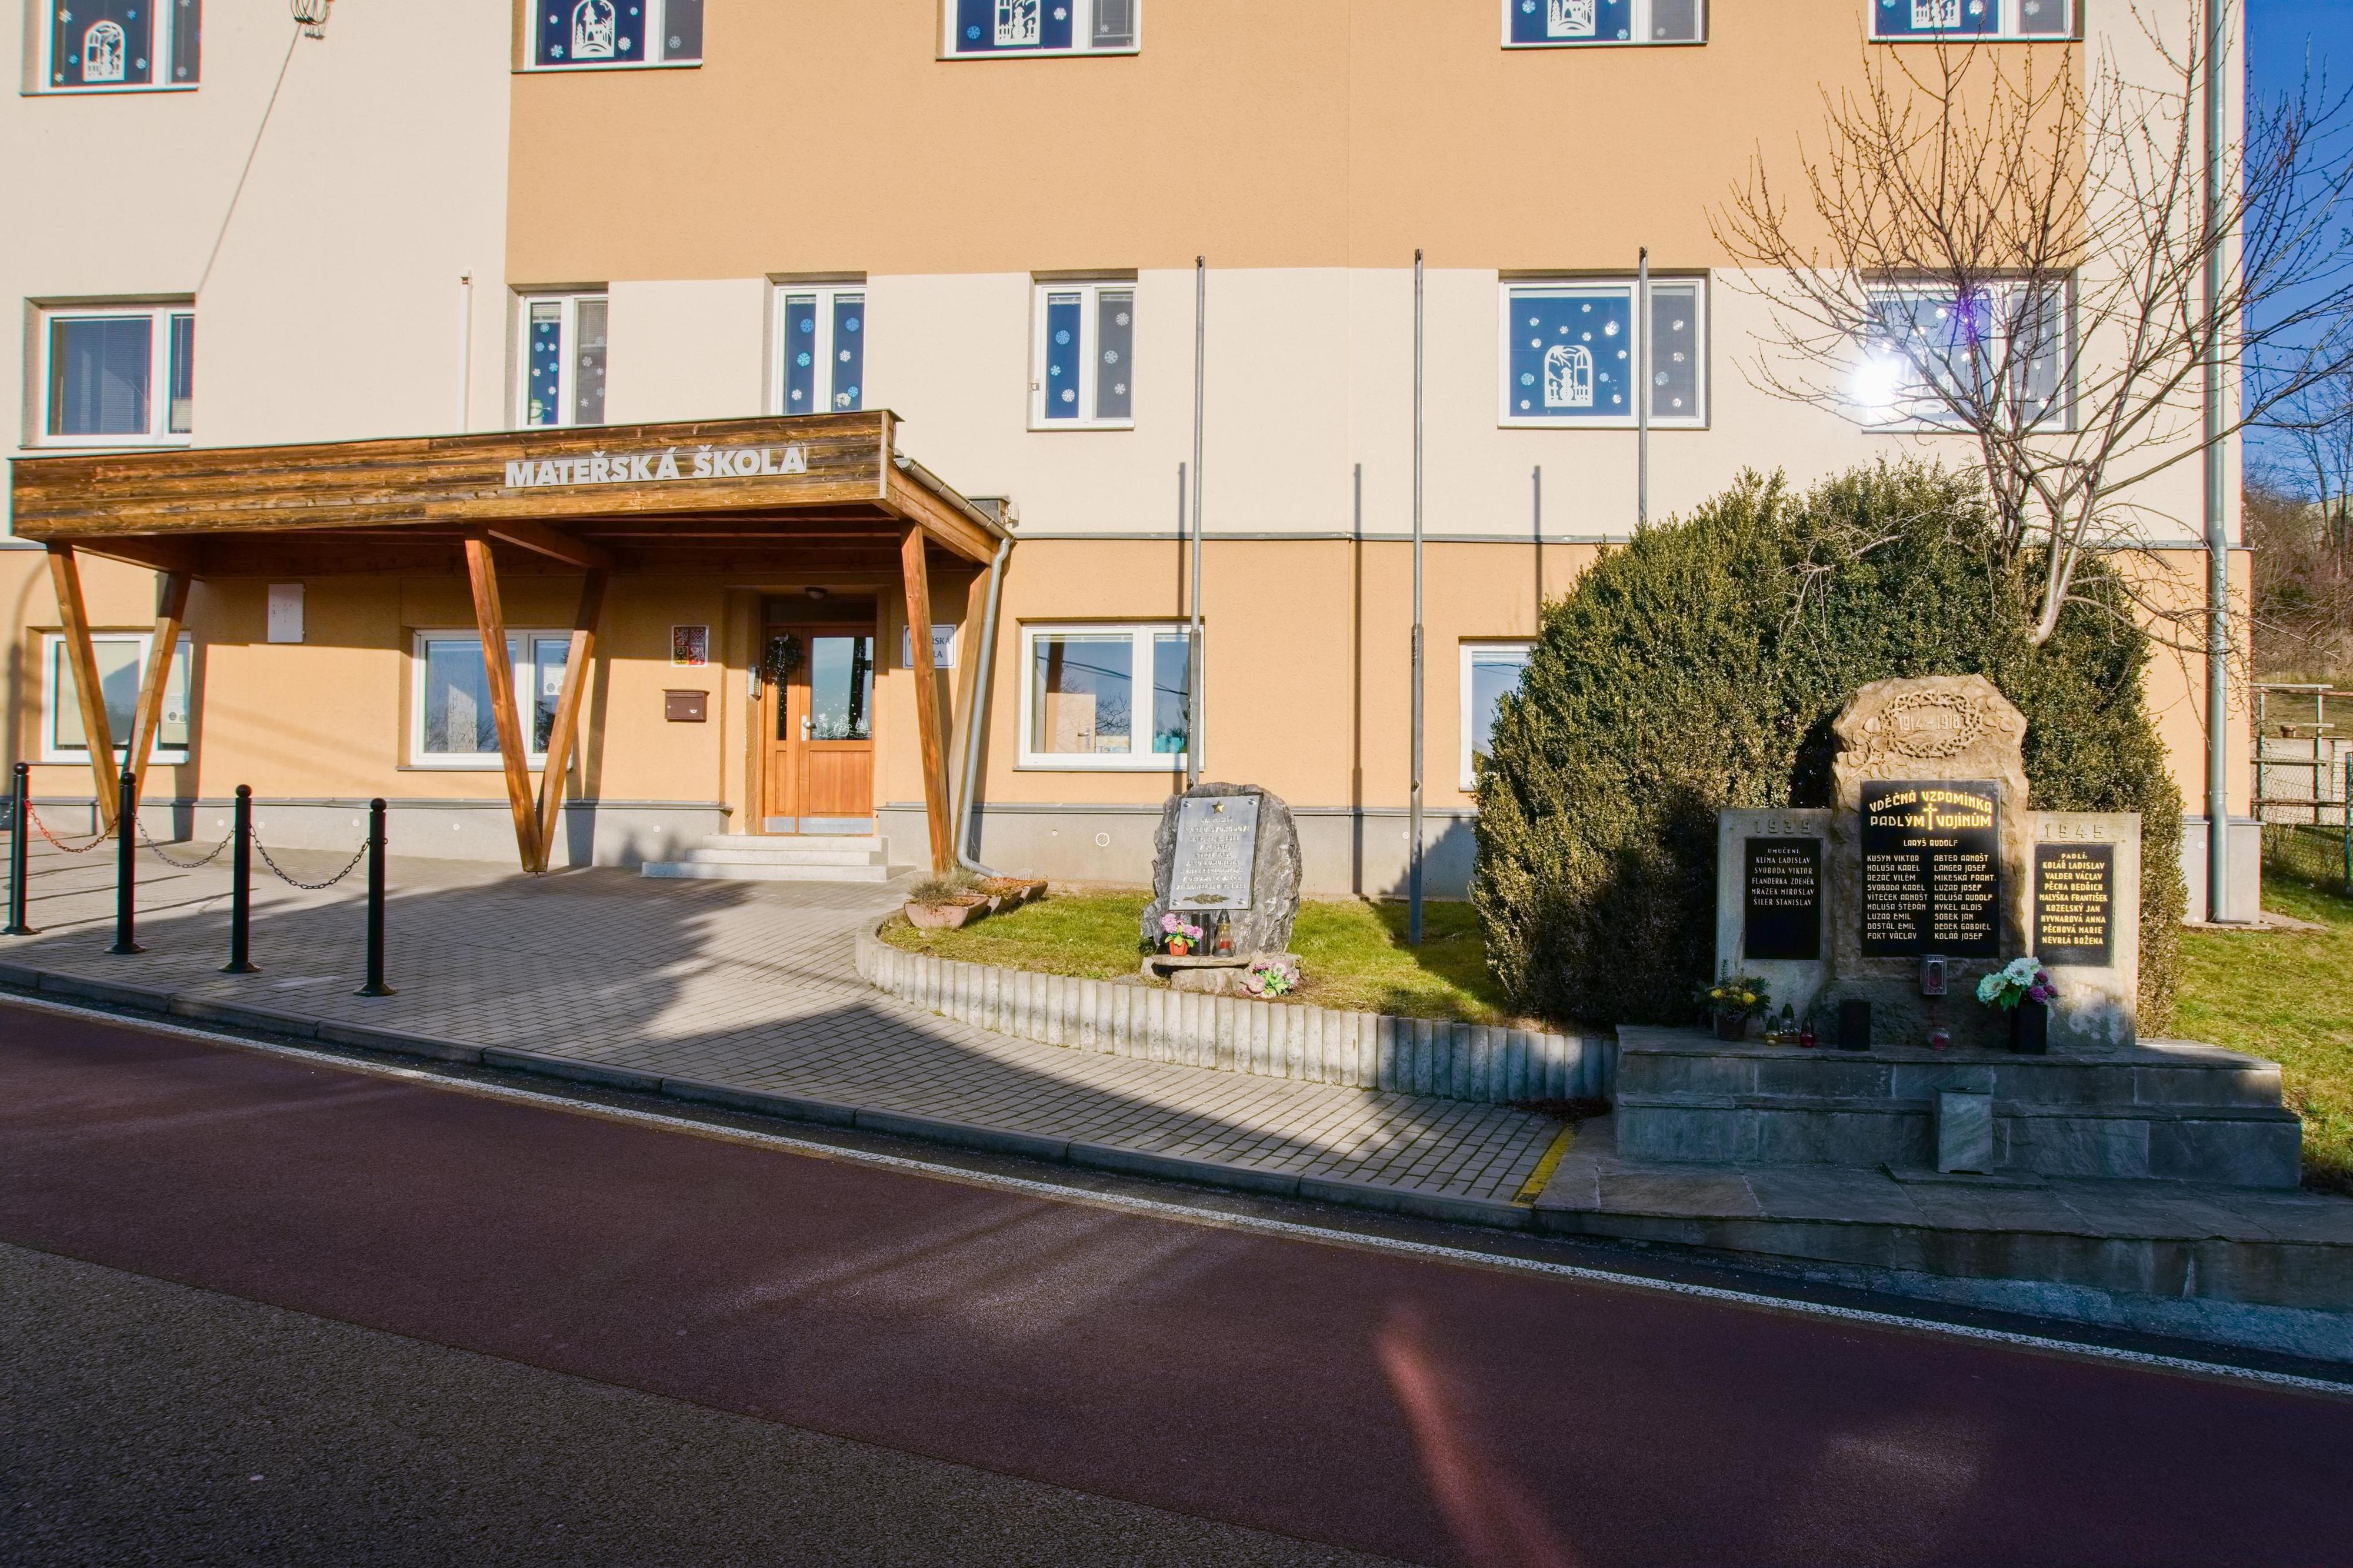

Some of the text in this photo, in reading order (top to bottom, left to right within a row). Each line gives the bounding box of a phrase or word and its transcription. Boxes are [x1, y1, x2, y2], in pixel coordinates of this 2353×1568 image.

[505, 445, 807, 488] MATEŘSKÁ ŠKOLA
[1869, 790, 1994, 814] VDĚČNÁ VZPOMÍNKA
[1871, 812, 1992, 829] PADLÝM VOJÍNŮM
[1755, 819, 1811, 834] 1939
[2045, 824, 2104, 838] 1945
[1904, 838, 1927, 847] LARYŠ
[1756, 855, 1776, 863] KLÍMA
[1961, 853, 1989, 862] ARNOŠT
[1867, 863, 1895, 872] HOLUŠA
[1965, 865, 1986, 873] JOSEF
[2042, 860, 2067, 869] KOLÁŘ
[1867, 873, 1916, 881] ŘEZÁČ VILÉM
[2075, 871, 2103, 880] VÁCLAV
[1791, 876, 1814, 885] ZDENĚK
[1751, 886, 1778, 895] MRÁZEK
[1961, 885, 1982, 893] JOSEF
[2045, 881, 2103, 891] PĚCHA BEDŘICH
[1754, 896, 1773, 905] ŠILER
[1867, 892, 1928, 900] VÍTEČEK ARNOŠT
[1934, 892, 1962, 901] HOLUŠA
[2039, 892, 2108, 902] MALYŠKA FRANTIŠEK
[1867, 902, 1926, 910] HOLUŠA ŠTĚPÁN
[2046, 903, 2084, 912] KOZELSKÝ
[1961, 913, 1974, 922] JAN
[2041, 913, 2083, 923] HYVNAROVÁ
[1867, 921, 1895, 930] DOSTÁL
[2043, 923, 2076, 933] PĚCHOVÁ
[1889, 931, 1917, 939] VÁCLAV
[1935, 931, 1983, 941] KOLÁŘ JOSEF
[2042, 935, 2103, 945] NEVRLÁ BOŽENA
